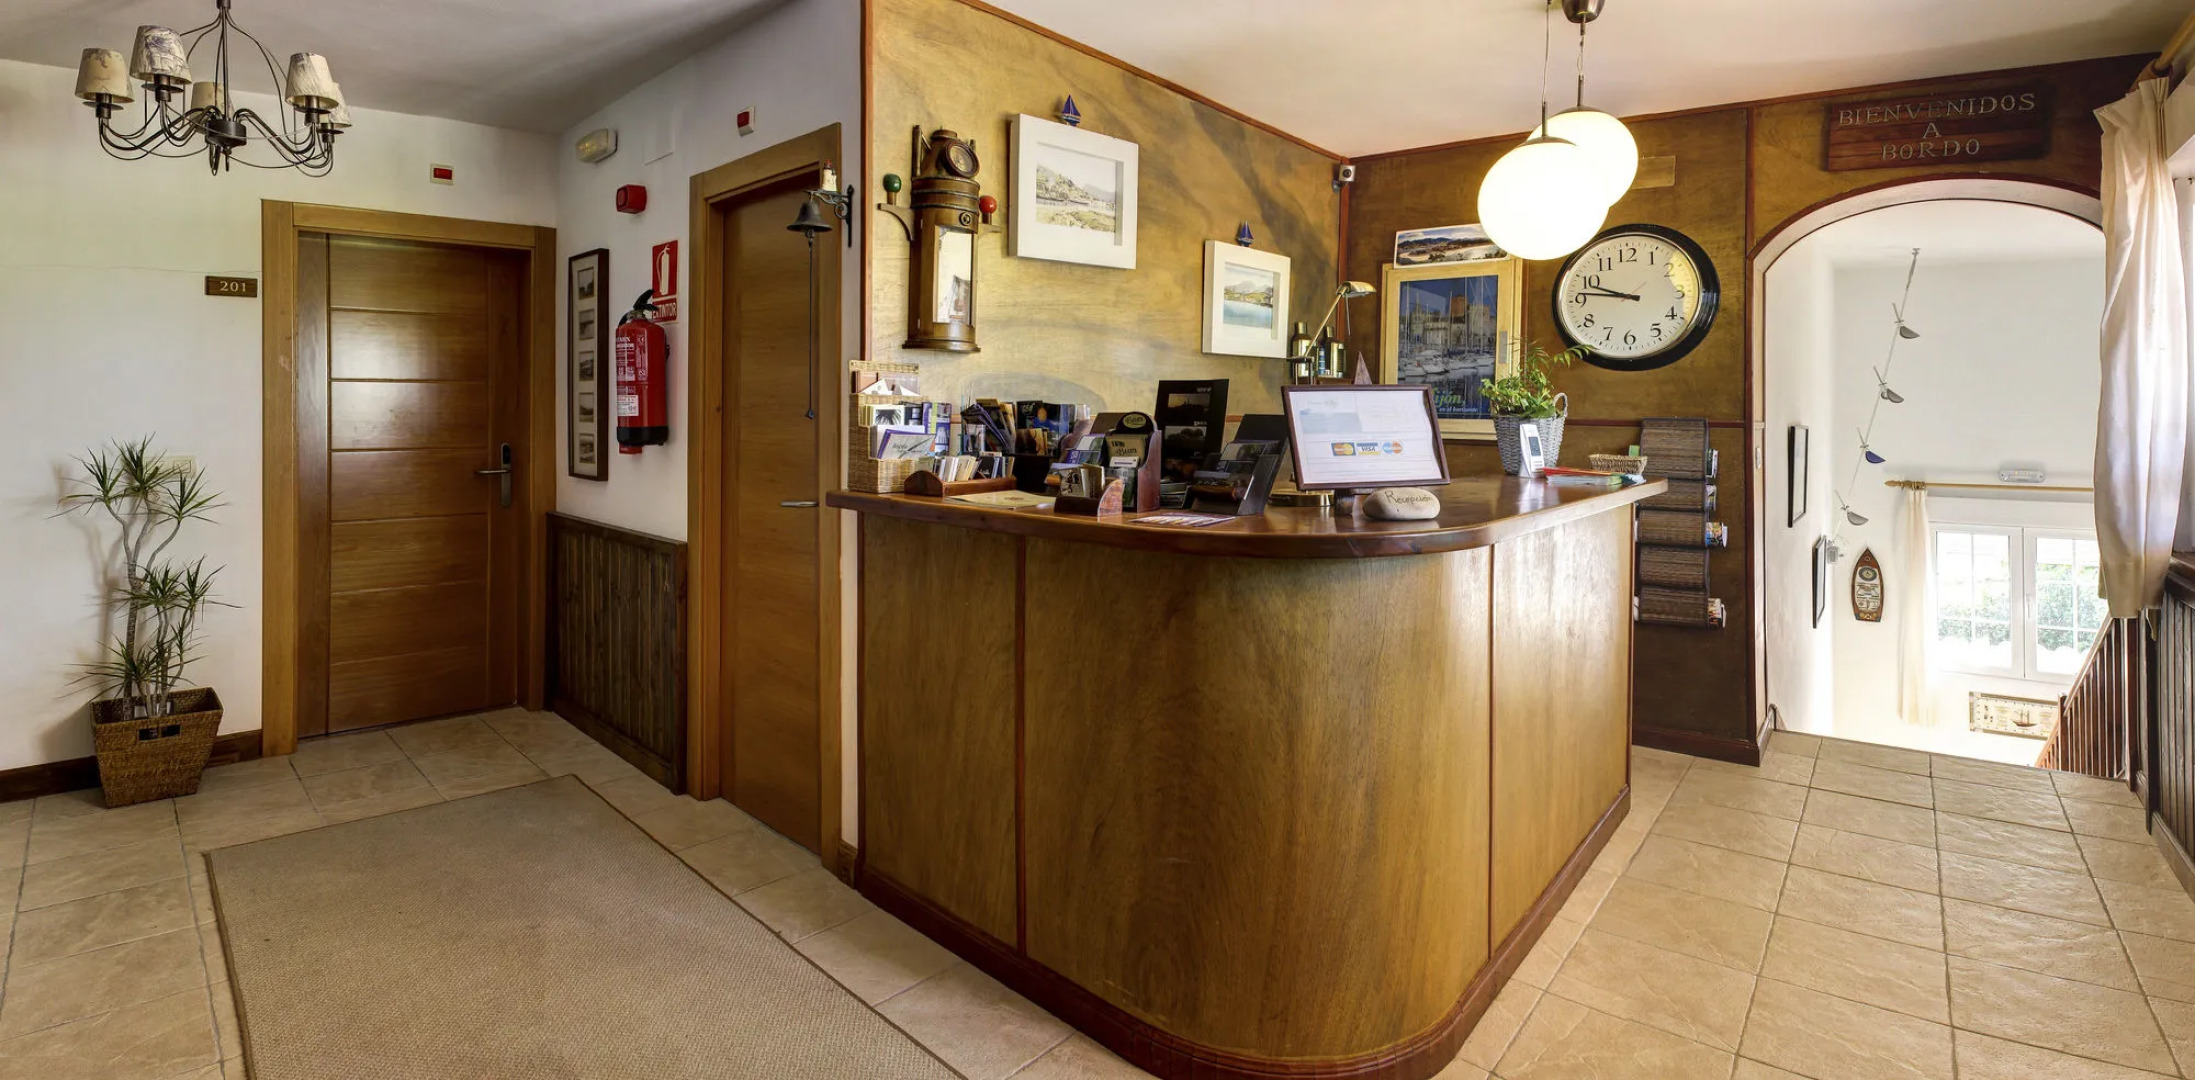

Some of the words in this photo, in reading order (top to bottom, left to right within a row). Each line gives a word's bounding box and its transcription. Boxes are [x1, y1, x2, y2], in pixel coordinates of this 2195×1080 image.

[1838, 92, 2036, 126] BIENVENIDOS
[1922, 122, 1943, 139] A
[1881, 138, 1981, 161] BORDO
[1618, 247, 1637, 263] 12
[1648, 250, 1655, 265] 1
[1598, 256, 1613, 272] 11
[1663, 262, 1675, 278] 2
[220, 280, 246, 292] 201
[1582, 274, 1600, 290] 10
[1674, 284, 1685, 299] 3
[1575, 292, 1587, 311] 9
[1583, 313, 1595, 328] 8
[1665, 305, 1677, 320] 4
[1603, 326, 1614, 341] 7
[1623, 329, 1636, 345] 6
[1651, 322, 1662, 338] 5
